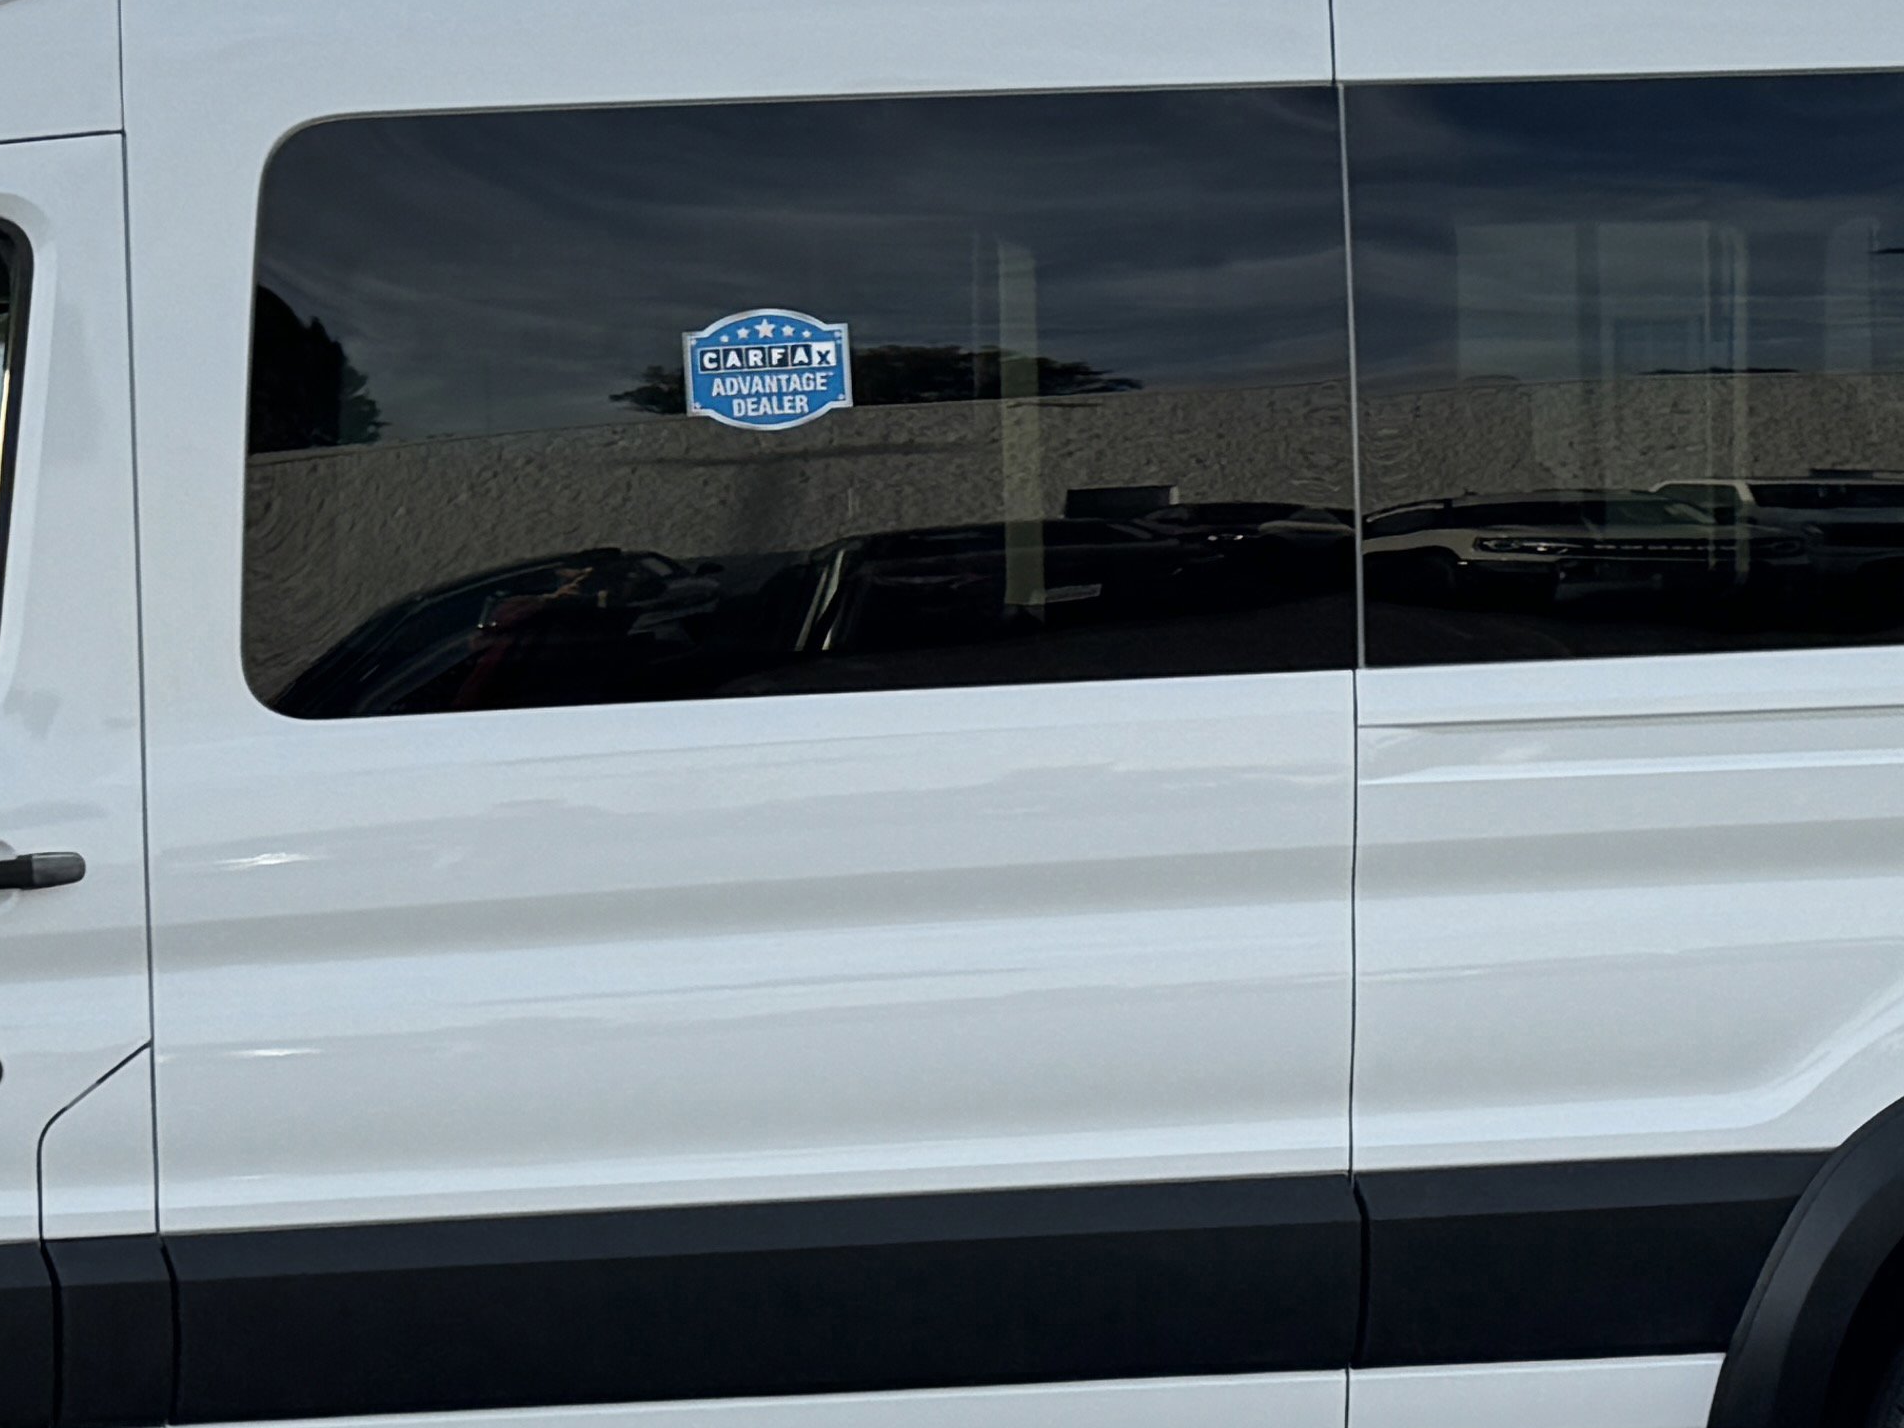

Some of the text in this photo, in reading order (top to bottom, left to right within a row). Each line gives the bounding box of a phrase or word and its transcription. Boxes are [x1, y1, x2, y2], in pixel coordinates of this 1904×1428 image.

[702, 345, 832, 370] CARFAX
[711, 372, 828, 397] ADVANTAGE
[732, 394, 810, 418] DEALER
